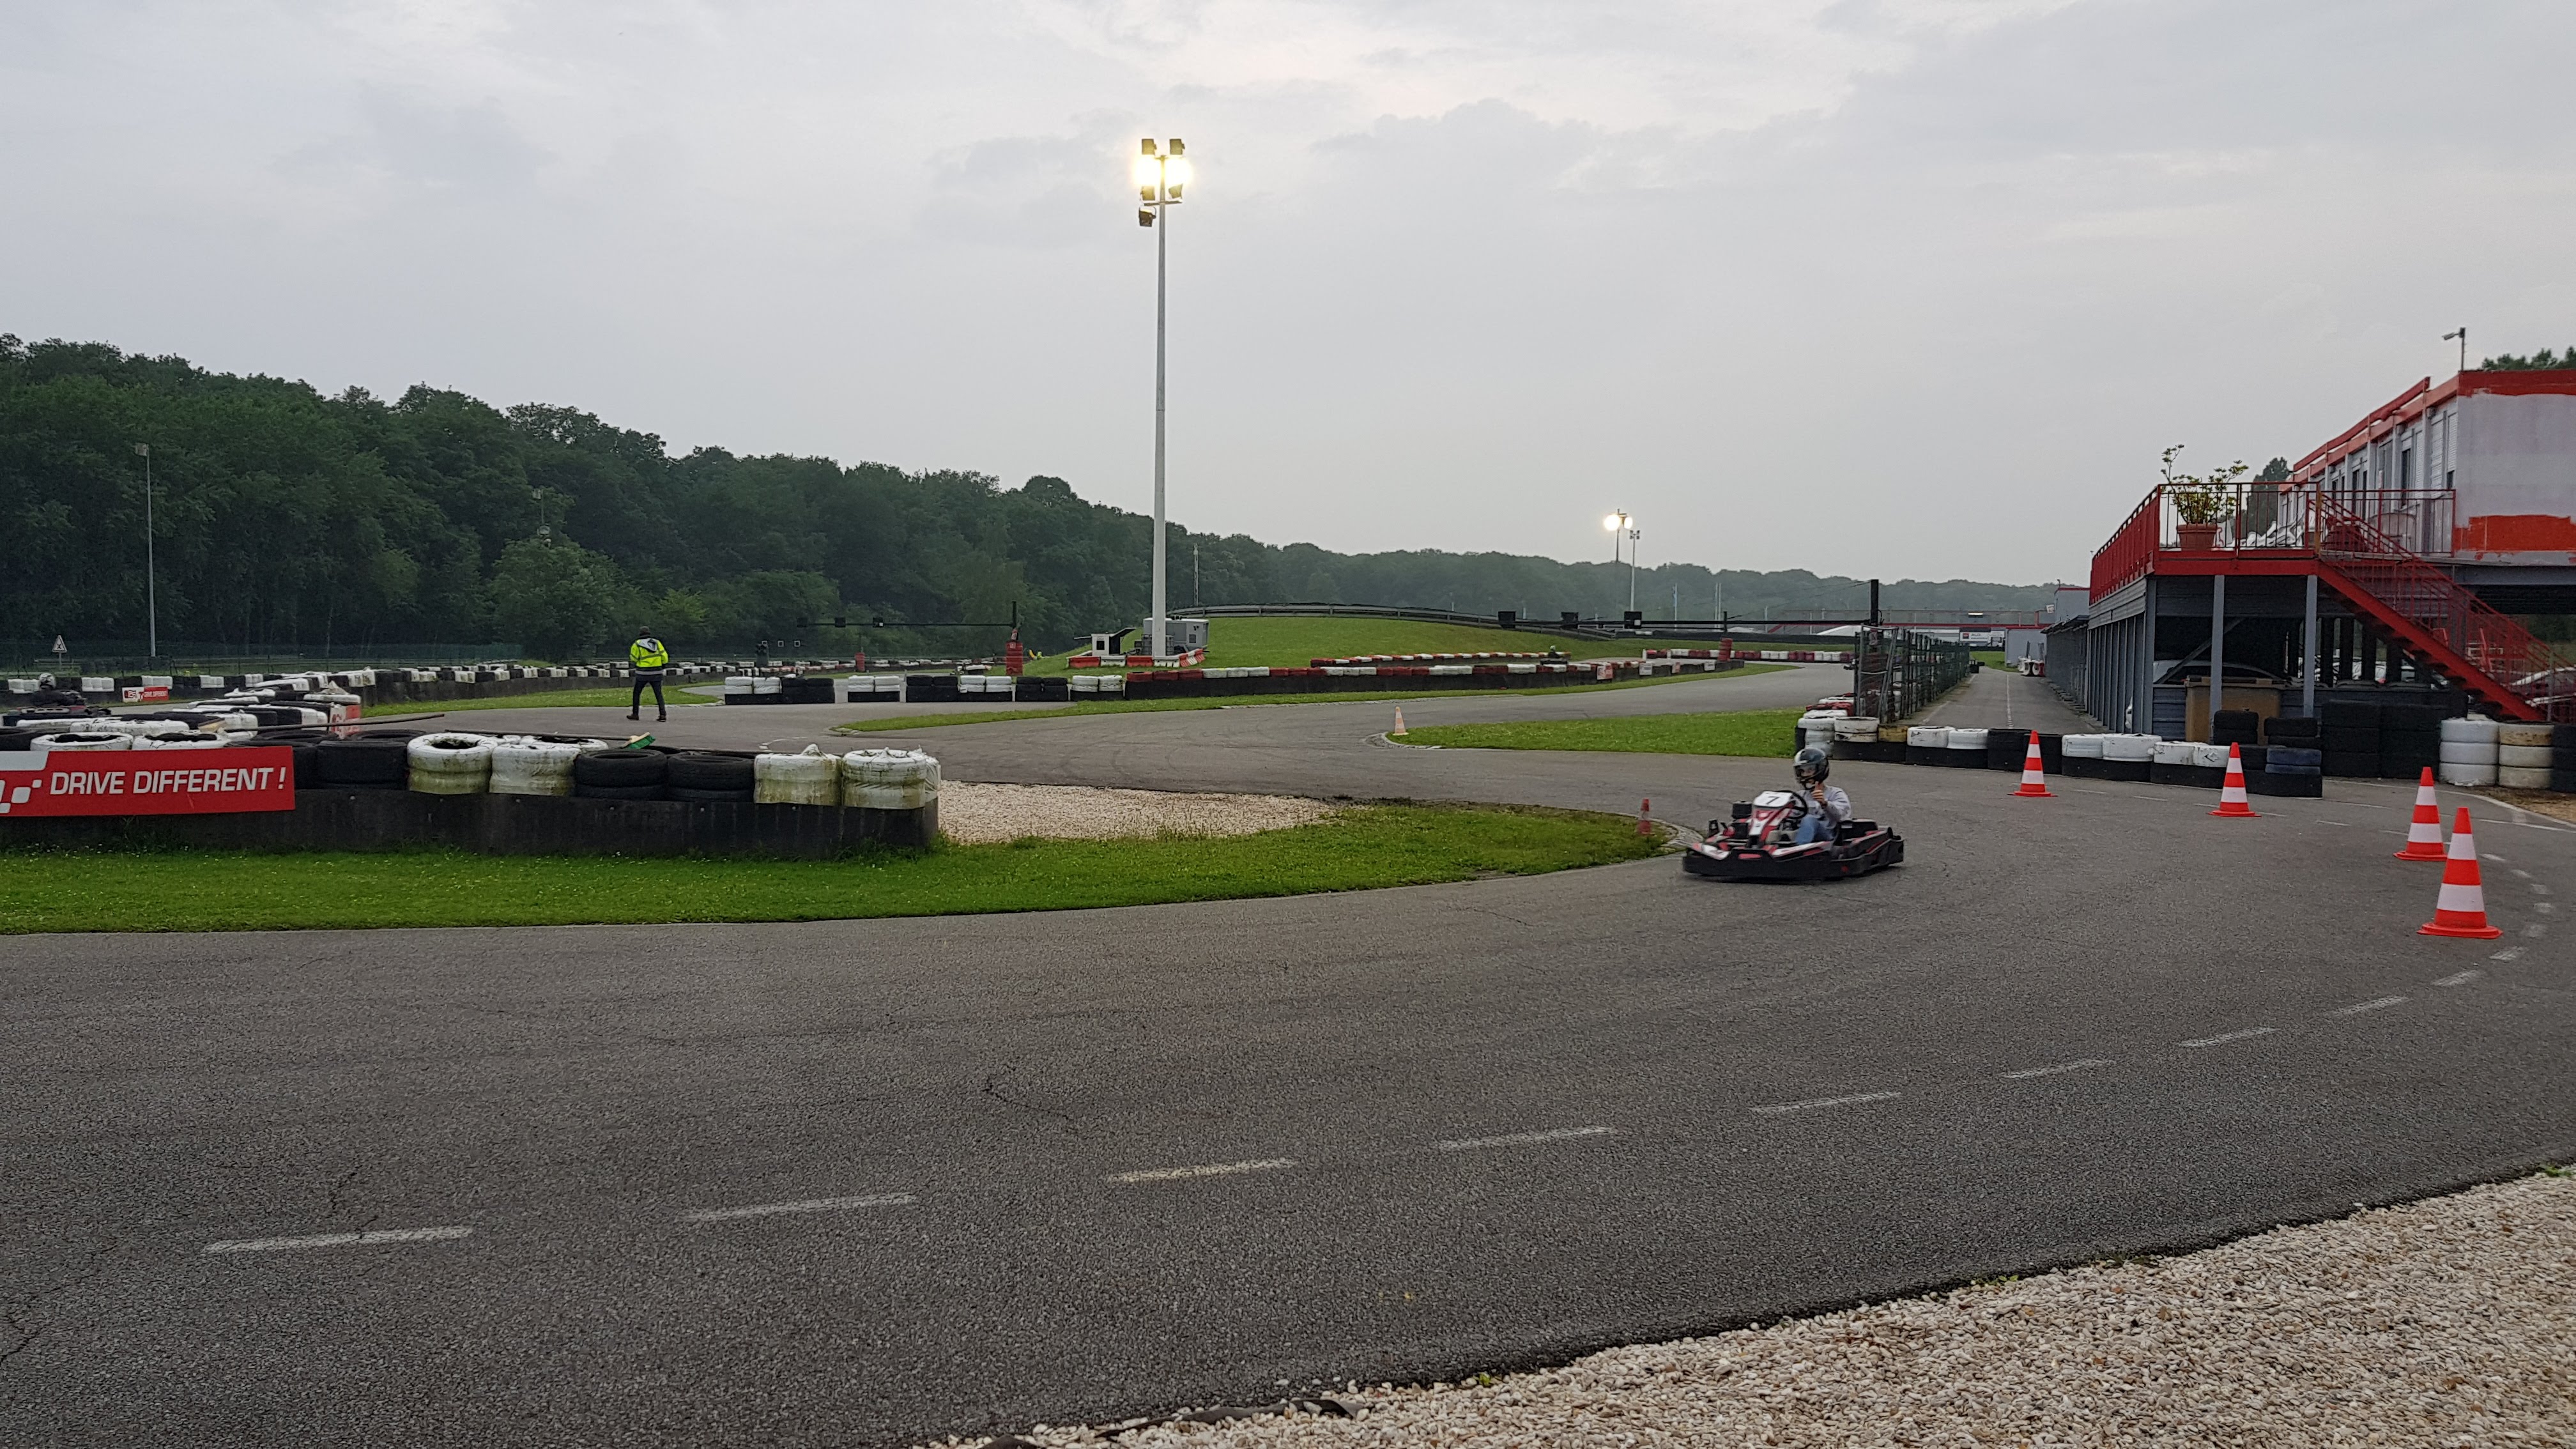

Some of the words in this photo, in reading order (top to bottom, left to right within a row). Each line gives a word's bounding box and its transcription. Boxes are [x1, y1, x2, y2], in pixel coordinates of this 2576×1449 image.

[50, 771, 126, 795] DRIVE
[133, 767, 273, 793] DIFFERENT
[1766, 796, 1780, 804] 7
